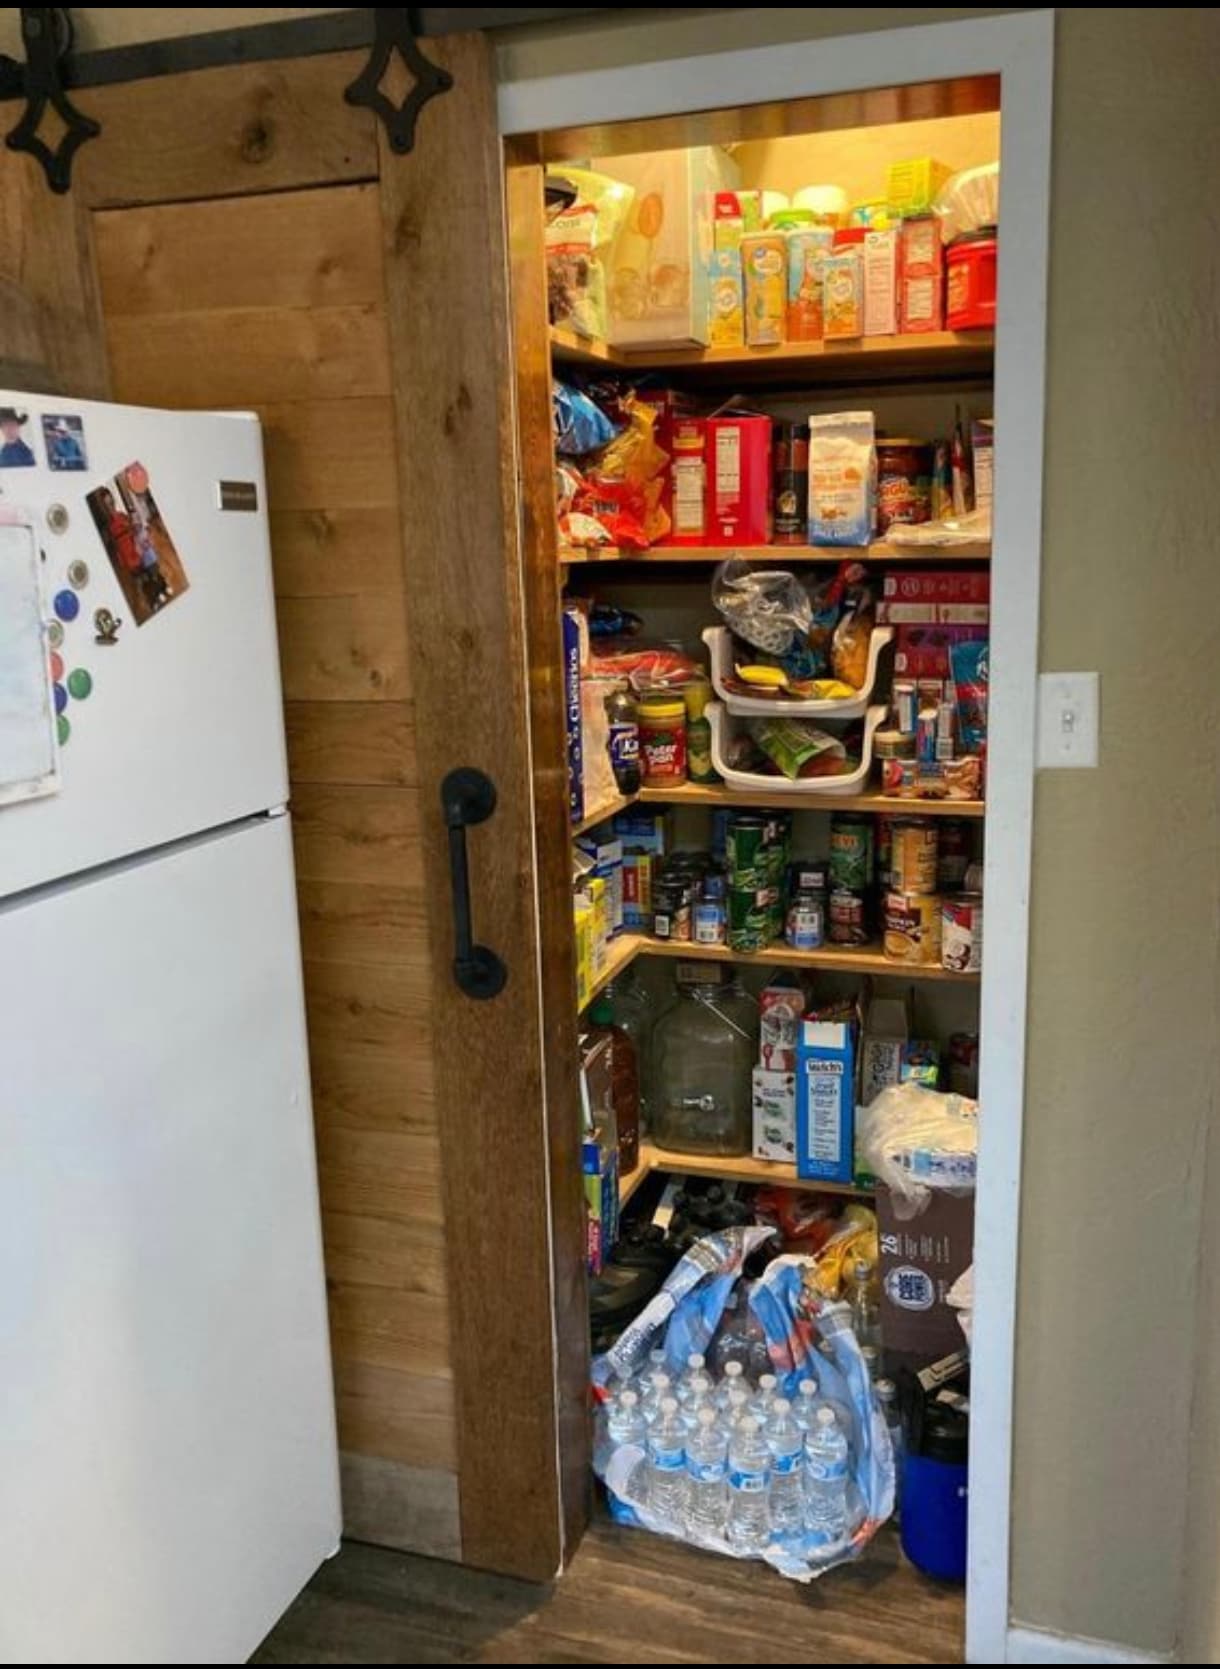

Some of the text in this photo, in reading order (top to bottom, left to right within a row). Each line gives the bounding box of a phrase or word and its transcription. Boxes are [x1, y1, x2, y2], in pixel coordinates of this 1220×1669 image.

[569, 648, 580, 722] Cheerios
[645, 744, 678, 757] Peter
[648, 753, 674, 767] Pan
[881, 1233, 898, 1254] 26
